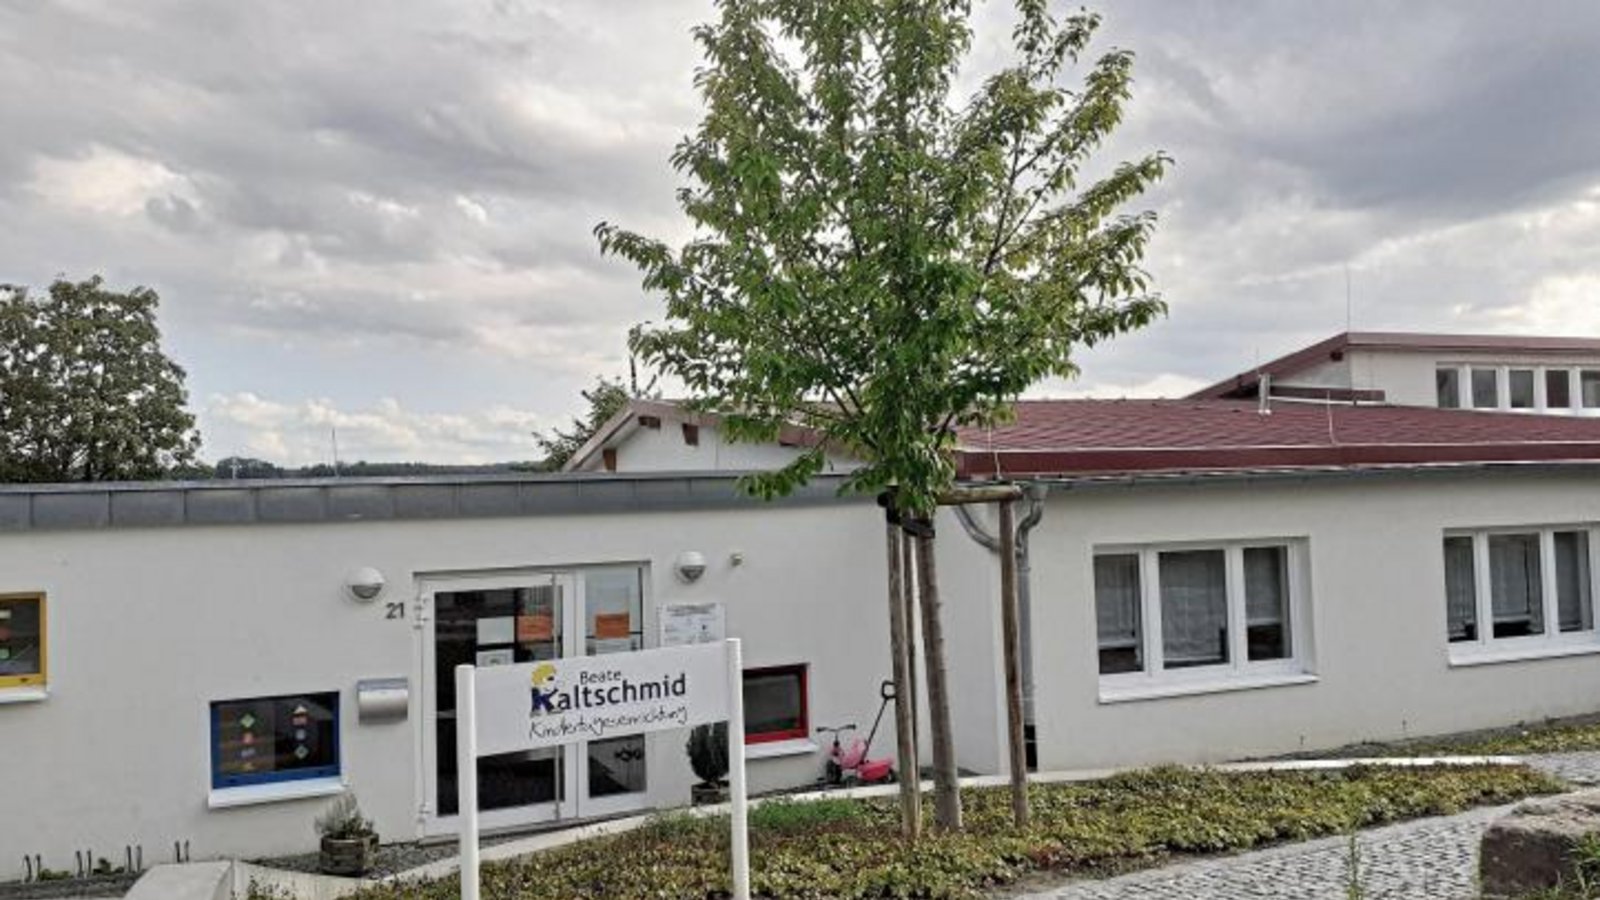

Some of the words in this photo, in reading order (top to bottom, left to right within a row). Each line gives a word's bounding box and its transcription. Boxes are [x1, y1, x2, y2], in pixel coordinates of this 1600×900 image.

[385, 602, 404, 619] 21
[580, 670, 622, 685] Beate
[531, 673, 686, 713] Kaltschmid
